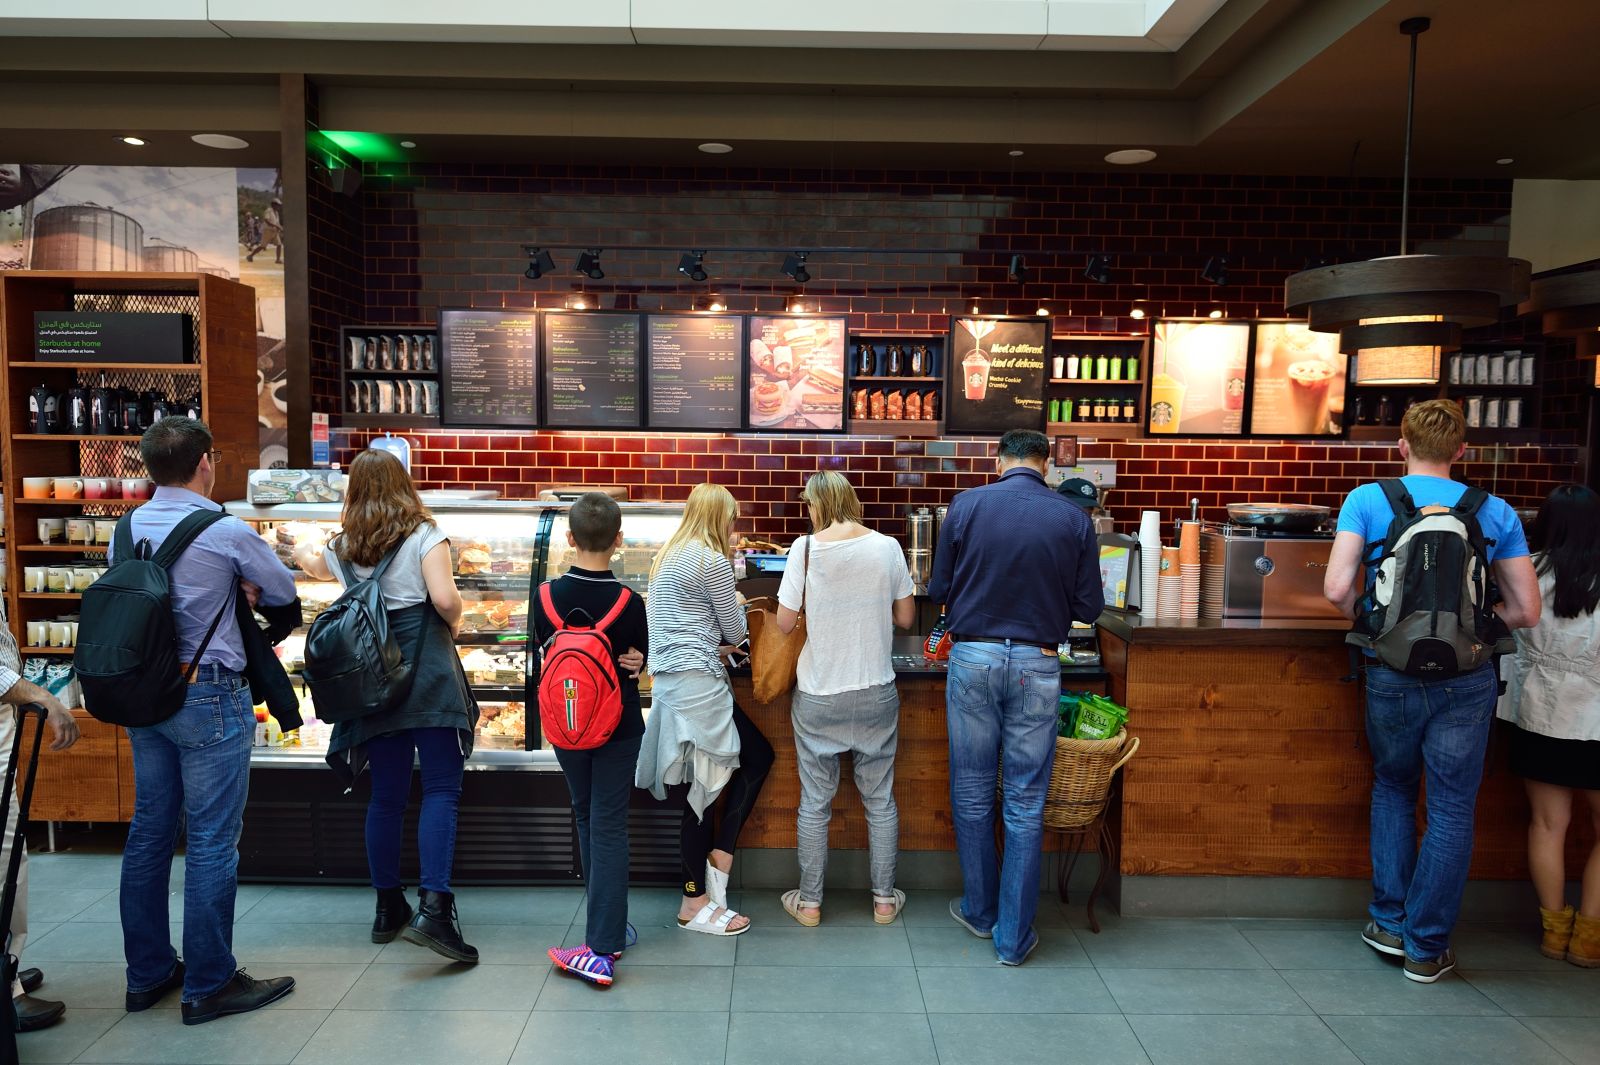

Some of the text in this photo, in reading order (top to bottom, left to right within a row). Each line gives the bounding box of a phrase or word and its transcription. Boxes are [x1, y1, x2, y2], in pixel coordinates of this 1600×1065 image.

[991, 344, 1009, 353] Meet
[1015, 344, 1043, 354] different
[991, 358, 1043, 369] kind of delicious
[1084, 711, 1107, 727] REAL
